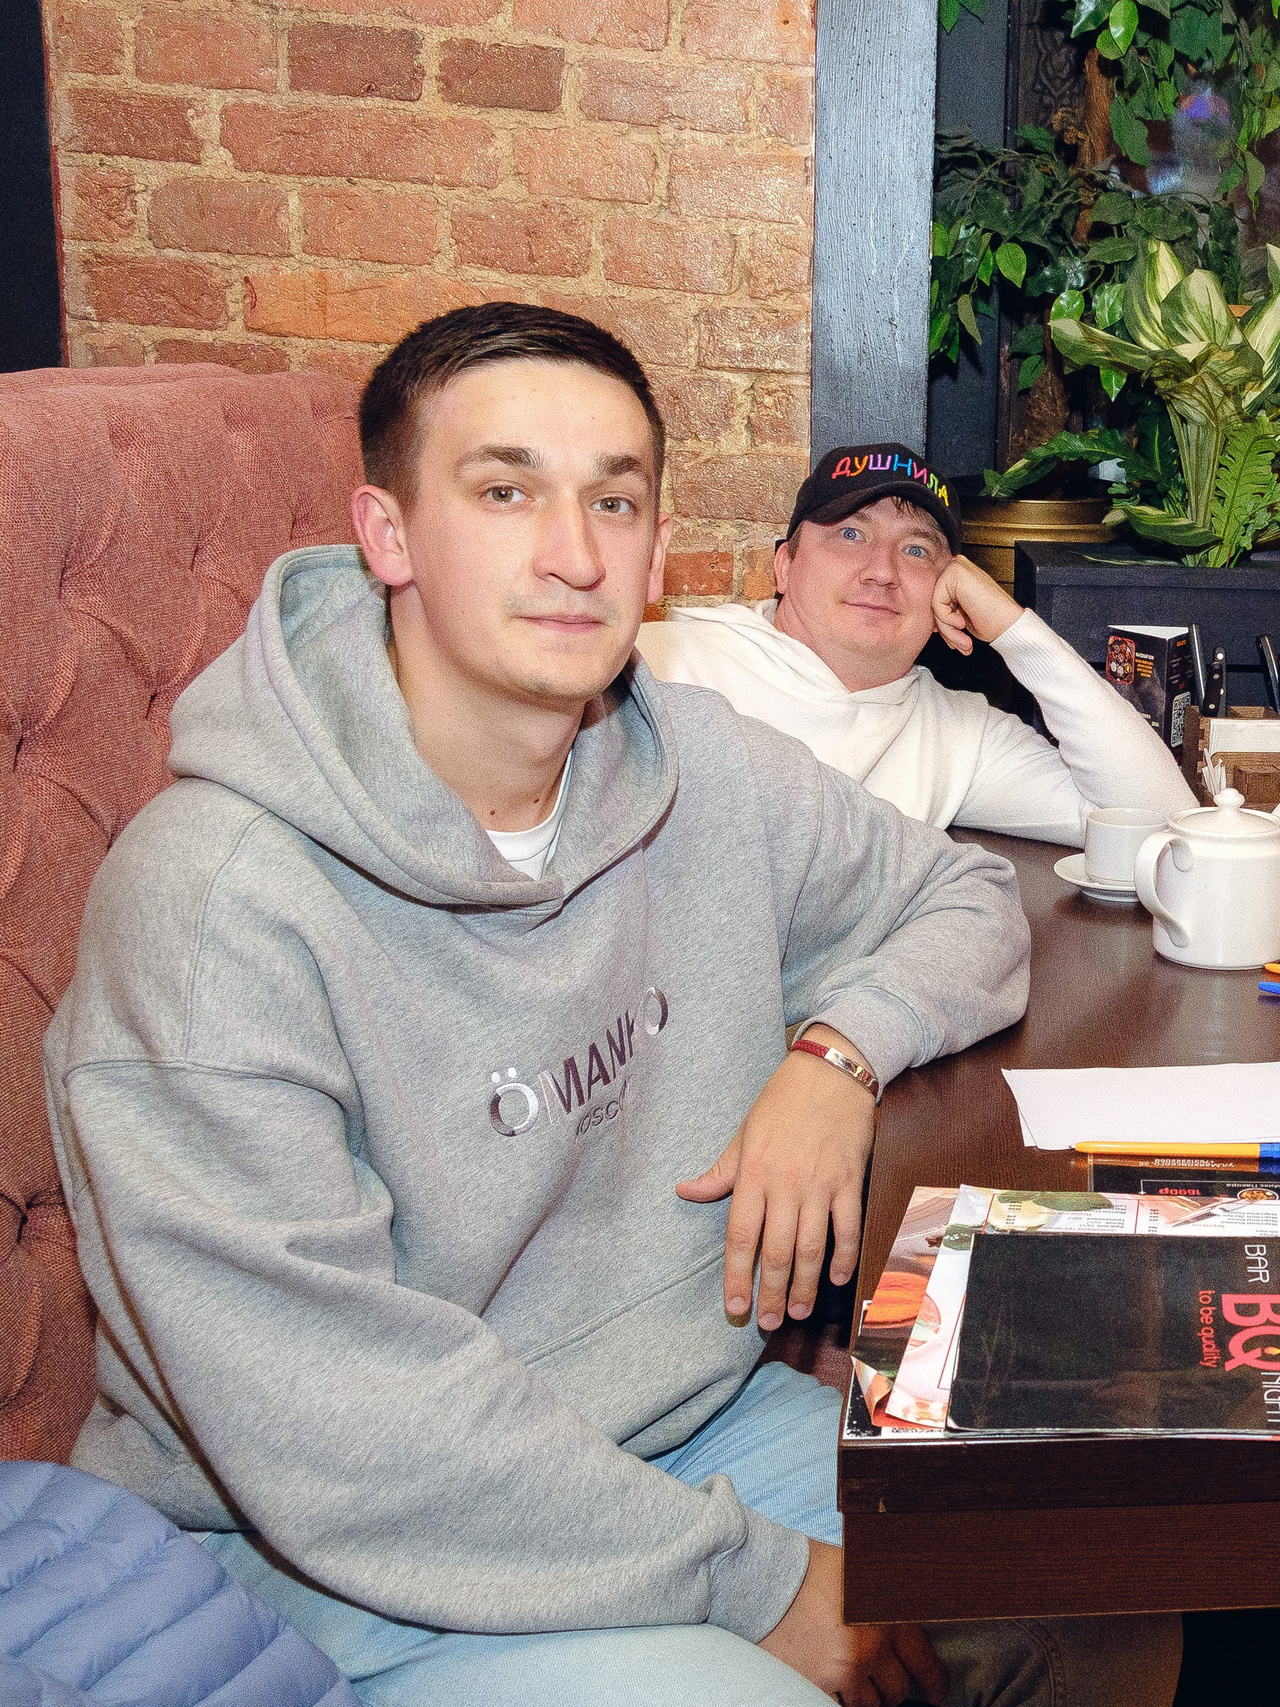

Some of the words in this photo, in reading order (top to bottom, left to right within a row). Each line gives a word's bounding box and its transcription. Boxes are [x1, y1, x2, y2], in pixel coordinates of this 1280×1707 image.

[831, 453, 949, 507] ДУШНИЛА
[1244, 1244, 1270, 1283] BAR
[1198, 1290, 1215, 1305] to
[1200, 1306, 1217, 1325] be
[1197, 1326, 1221, 1368] quality
